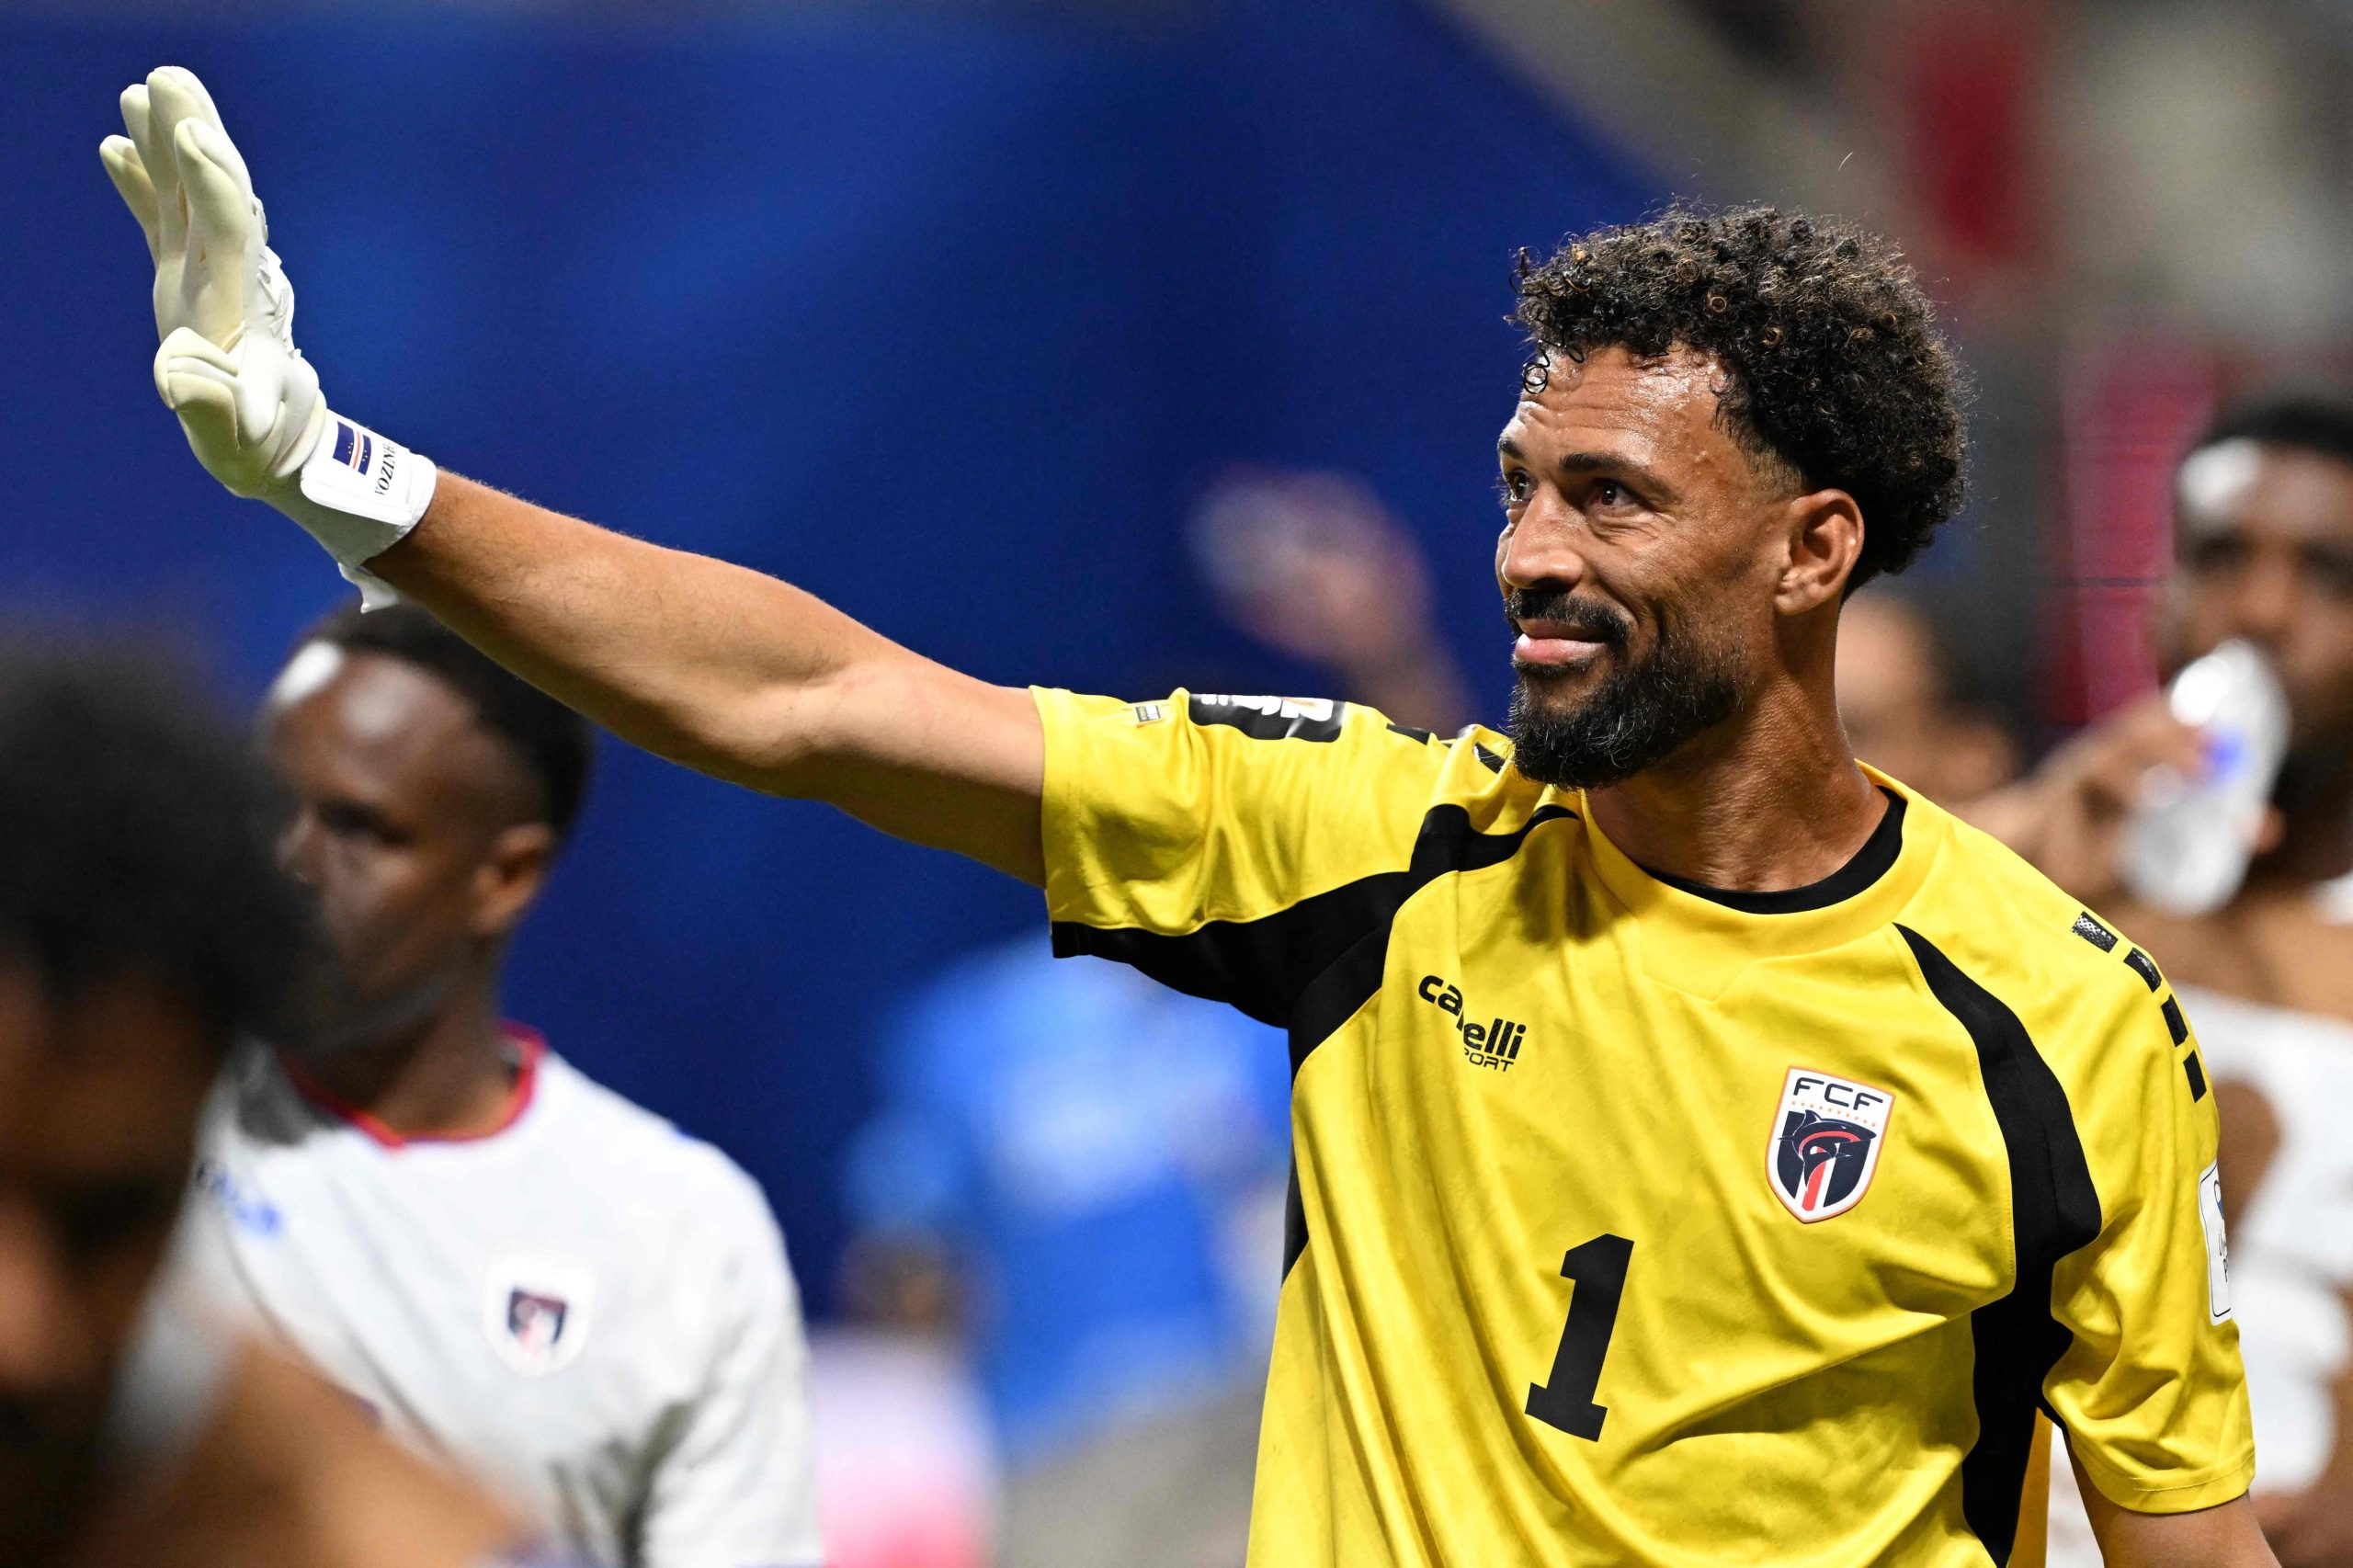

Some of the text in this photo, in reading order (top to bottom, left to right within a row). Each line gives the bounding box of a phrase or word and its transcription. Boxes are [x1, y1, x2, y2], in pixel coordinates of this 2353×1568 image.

[374, 443, 395, 496] VOZINH
[1418, 974, 1527, 1060] caelli
[1463, 1047, 1515, 1073] ORT
[1793, 1076, 1883, 1111] FCF
[1524, 1233, 1635, 1443] 1
